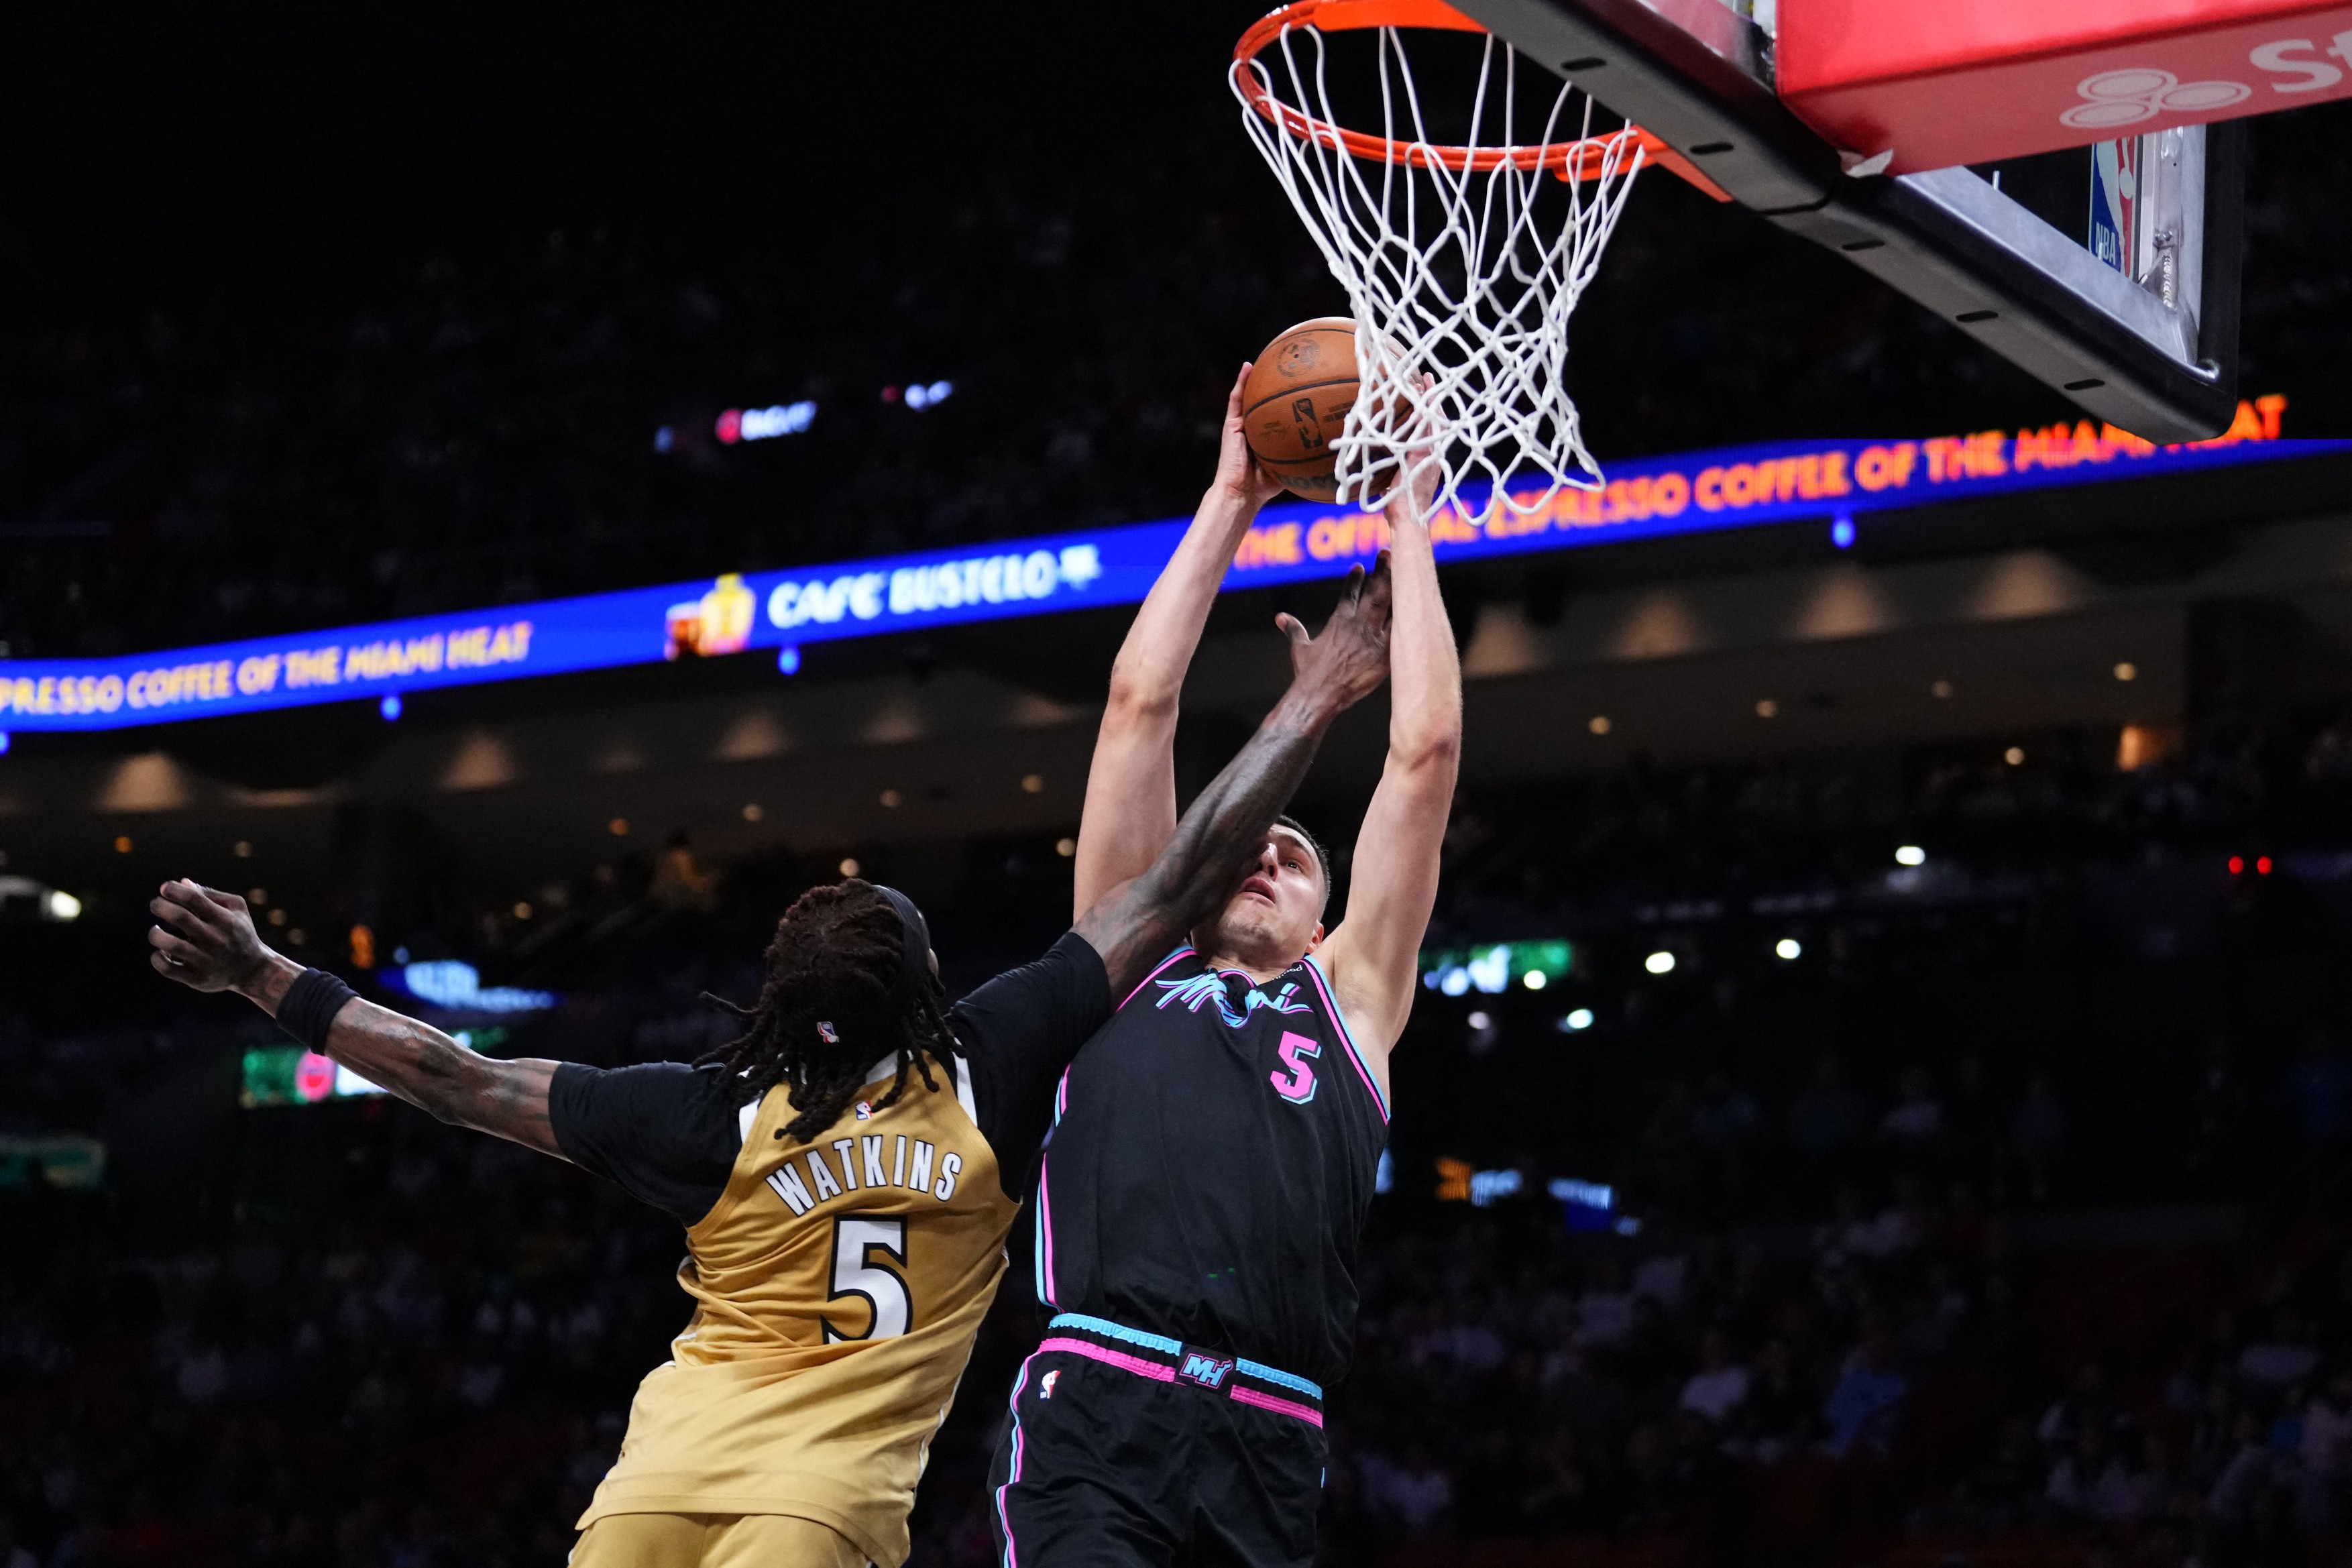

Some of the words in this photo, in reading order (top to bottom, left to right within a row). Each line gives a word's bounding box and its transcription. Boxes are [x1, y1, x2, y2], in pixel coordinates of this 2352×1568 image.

[2095, 221, 2117, 266] NBA
[1485, 471, 1691, 539] ESPRESSO
[1694, 452, 1850, 512] COFFEE
[1854, 443, 1917, 492] OF
[1923, 430, 2008, 482] THE
[889, 550, 1058, 615] BUSTELO
[126, 659, 235, 710] COFFEE
[236, 653, 282, 695] OF
[285, 645, 342, 689] THE
[344, 632, 445, 682] MIAMI
[446, 620, 534, 670] HEAT
[1270, 1031, 1321, 1105] 5
[766, 1135, 963, 1217] WATKINS
[820, 1215, 913, 1345] 5
[1180, 1354, 1233, 1388] MH
